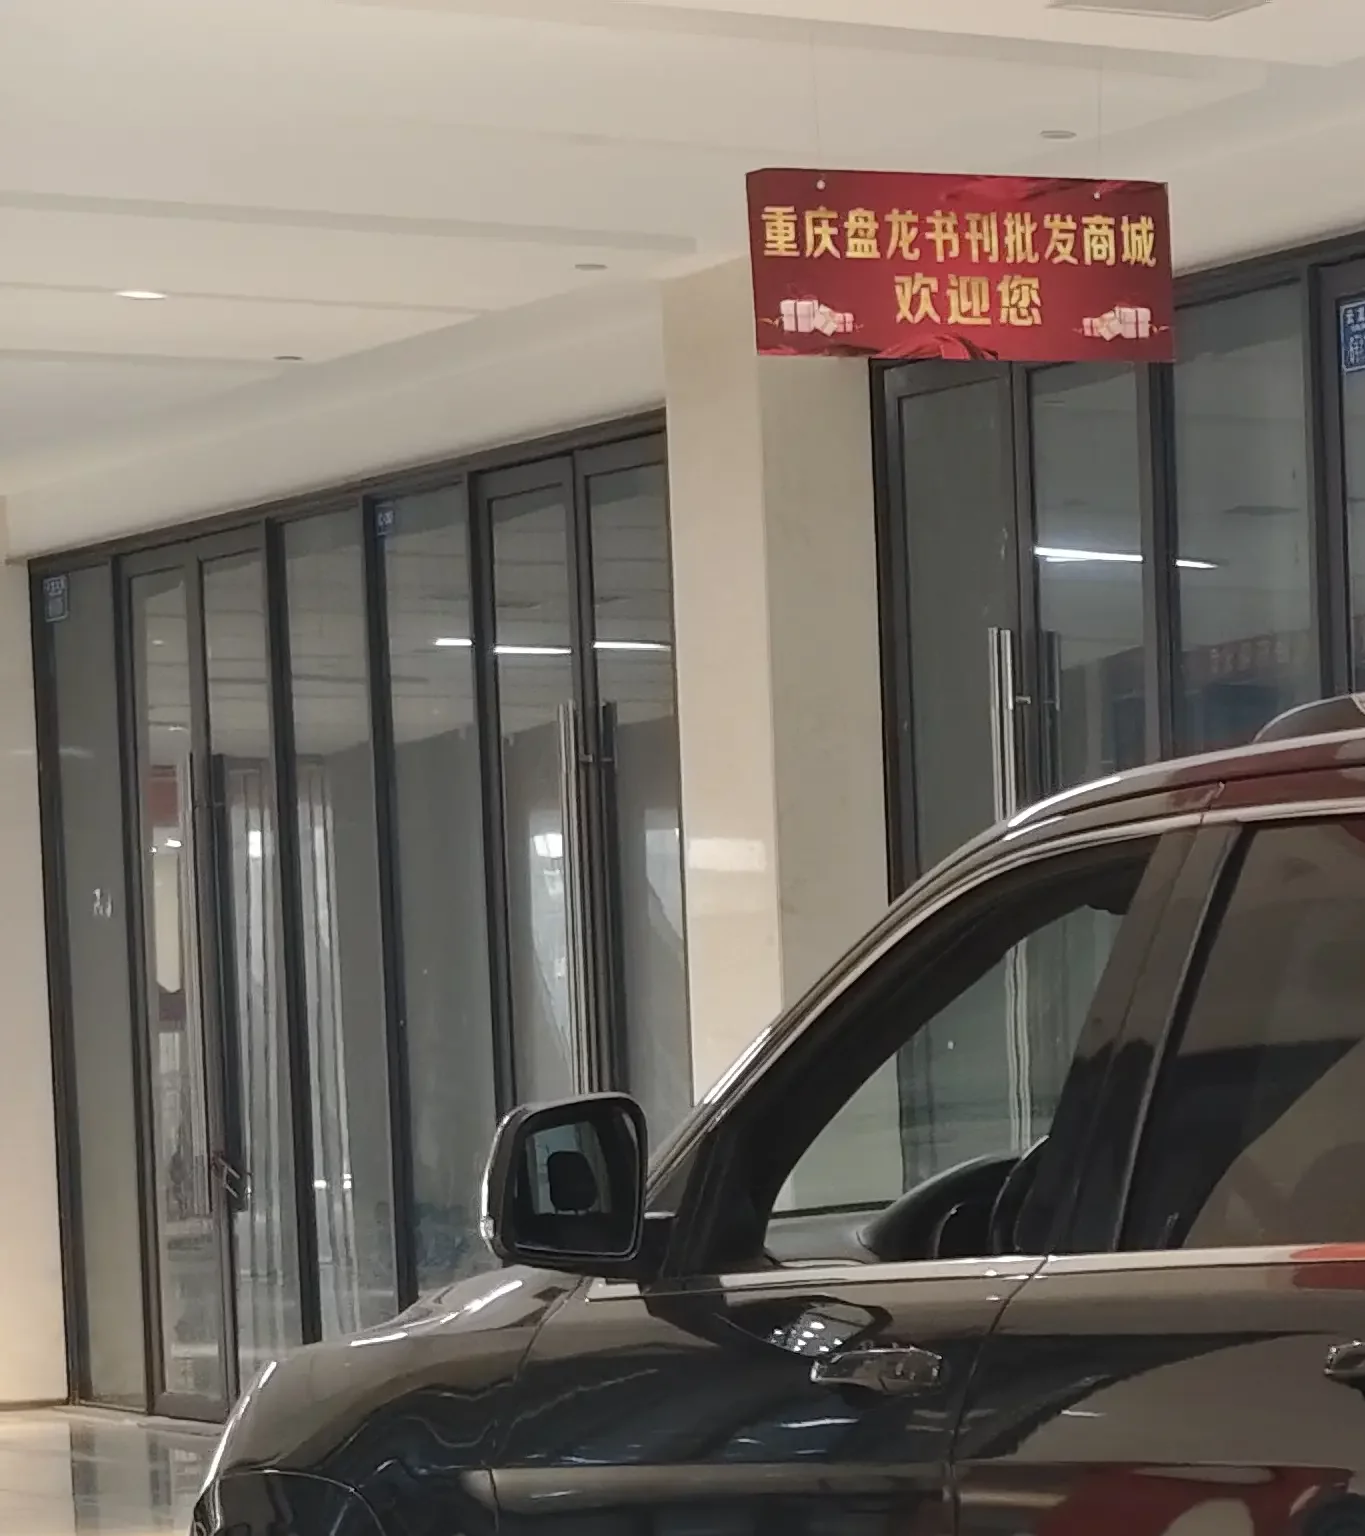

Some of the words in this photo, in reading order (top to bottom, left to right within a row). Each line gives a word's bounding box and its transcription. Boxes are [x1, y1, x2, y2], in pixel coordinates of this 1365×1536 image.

[761, 205, 1157, 267] 重庆盘龙书刊批发商城
[894, 272, 1043, 327] 欢迎您
